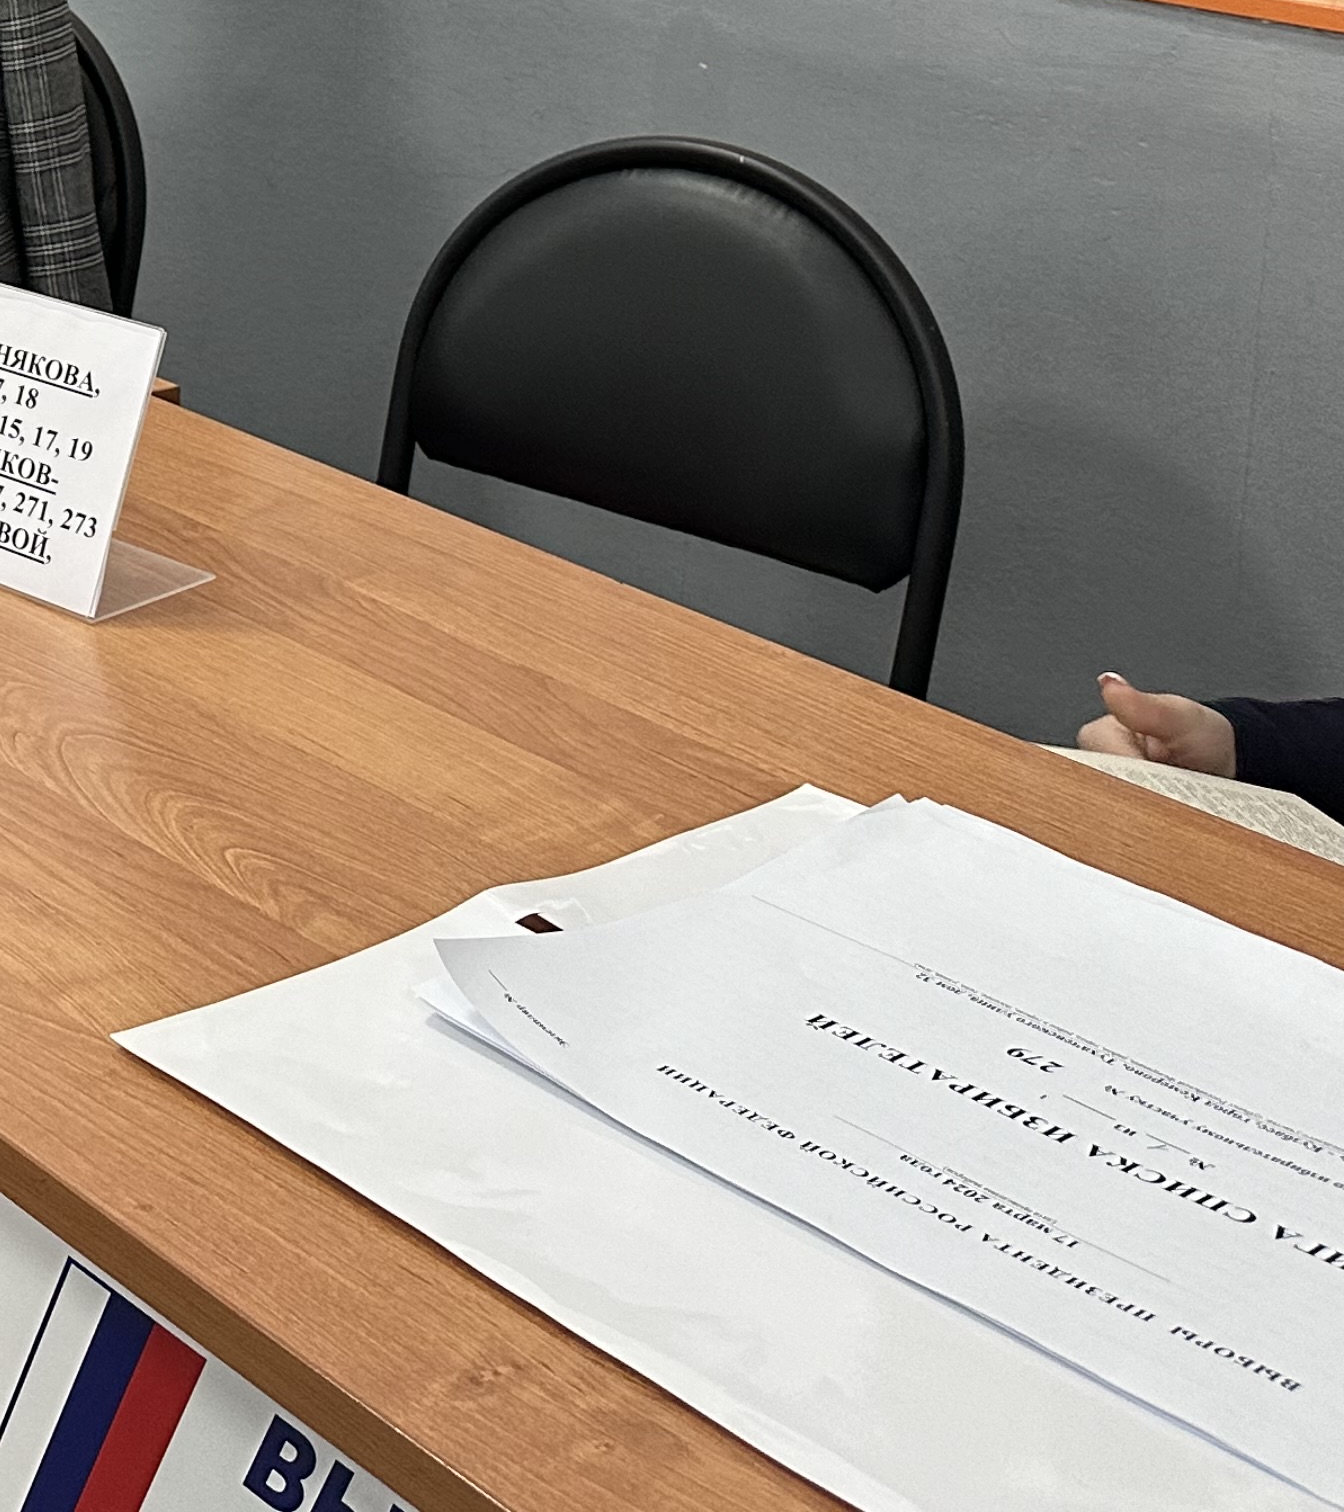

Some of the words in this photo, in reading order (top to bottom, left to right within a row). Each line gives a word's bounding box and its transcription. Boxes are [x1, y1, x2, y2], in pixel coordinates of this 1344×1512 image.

[15, 383, 40, 410] 18
[0, 414, 26, 446] 15,
[32, 424, 61, 458] 17,
[67, 436, 95, 462] 19
[13, 491, 55, 530] 271,
[60, 507, 98, 539] 273
[803, 1013, 1080, 1144] ИЗБИРАТЕЛЕЙ
[1006, 1047, 1066, 1074] 279
[655, 1064, 796, 1141] ФЕДЕРАЦИИ
[798, 1140, 974, 1233] РОССИЙСКОЙ
[899, 1153, 943, 1179] года
[1088, 1143, 1258, 1224] СПИСКА
[941, 1177, 992, 1204] 2024
[991, 1201, 1053, 1234] марта
[1052, 1234, 1081, 1249] 17
[1274, 1223, 1344, 1271] ИГА
[981, 1231, 1157, 1323] ПРЕЗИДЕНТА
[1169, 1324, 1303, 1392] ВЫБОРЫ
